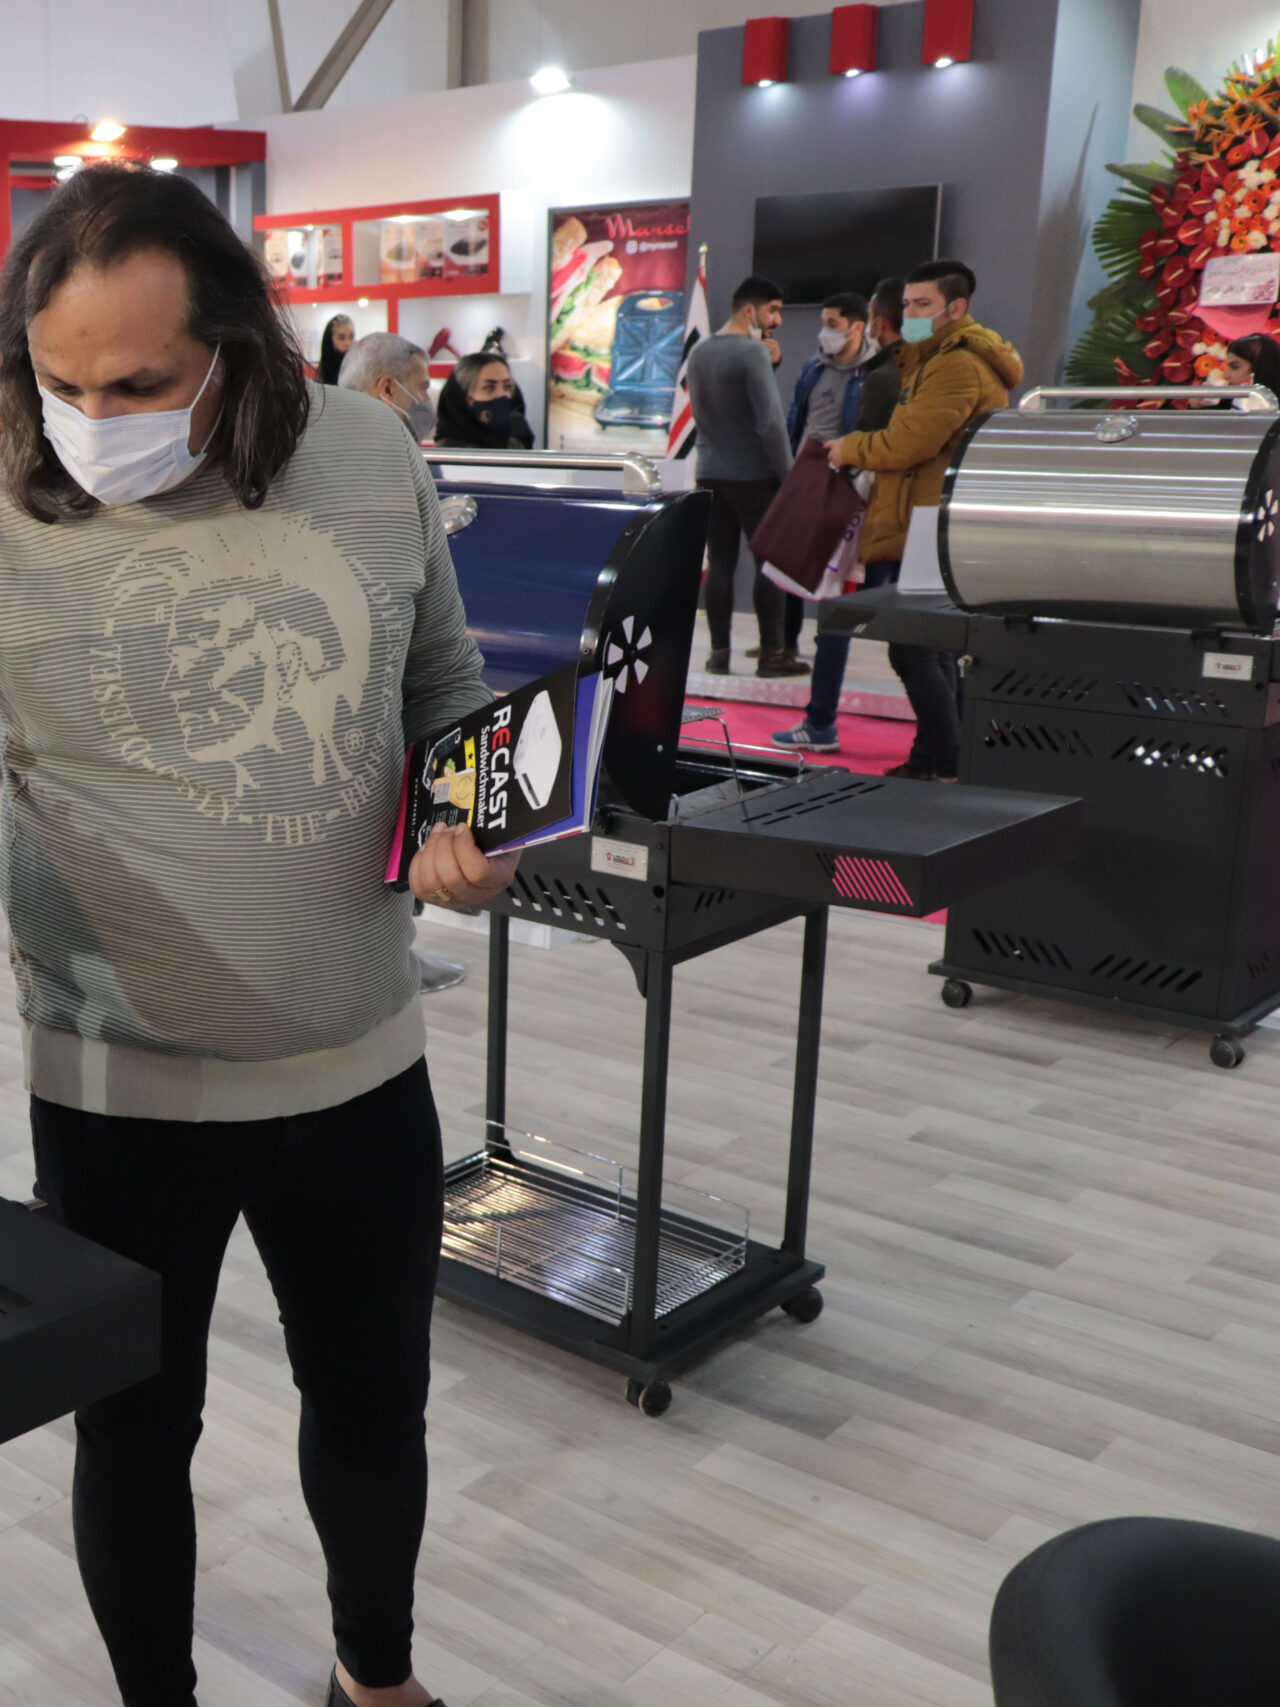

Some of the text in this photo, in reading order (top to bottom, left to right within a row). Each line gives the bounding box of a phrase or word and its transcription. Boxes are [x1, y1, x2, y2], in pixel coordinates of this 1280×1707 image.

[476, 724, 491, 829] Sandwichmaker
[487, 704, 512, 830] RECAST
[261, 811, 326, 845] THE
